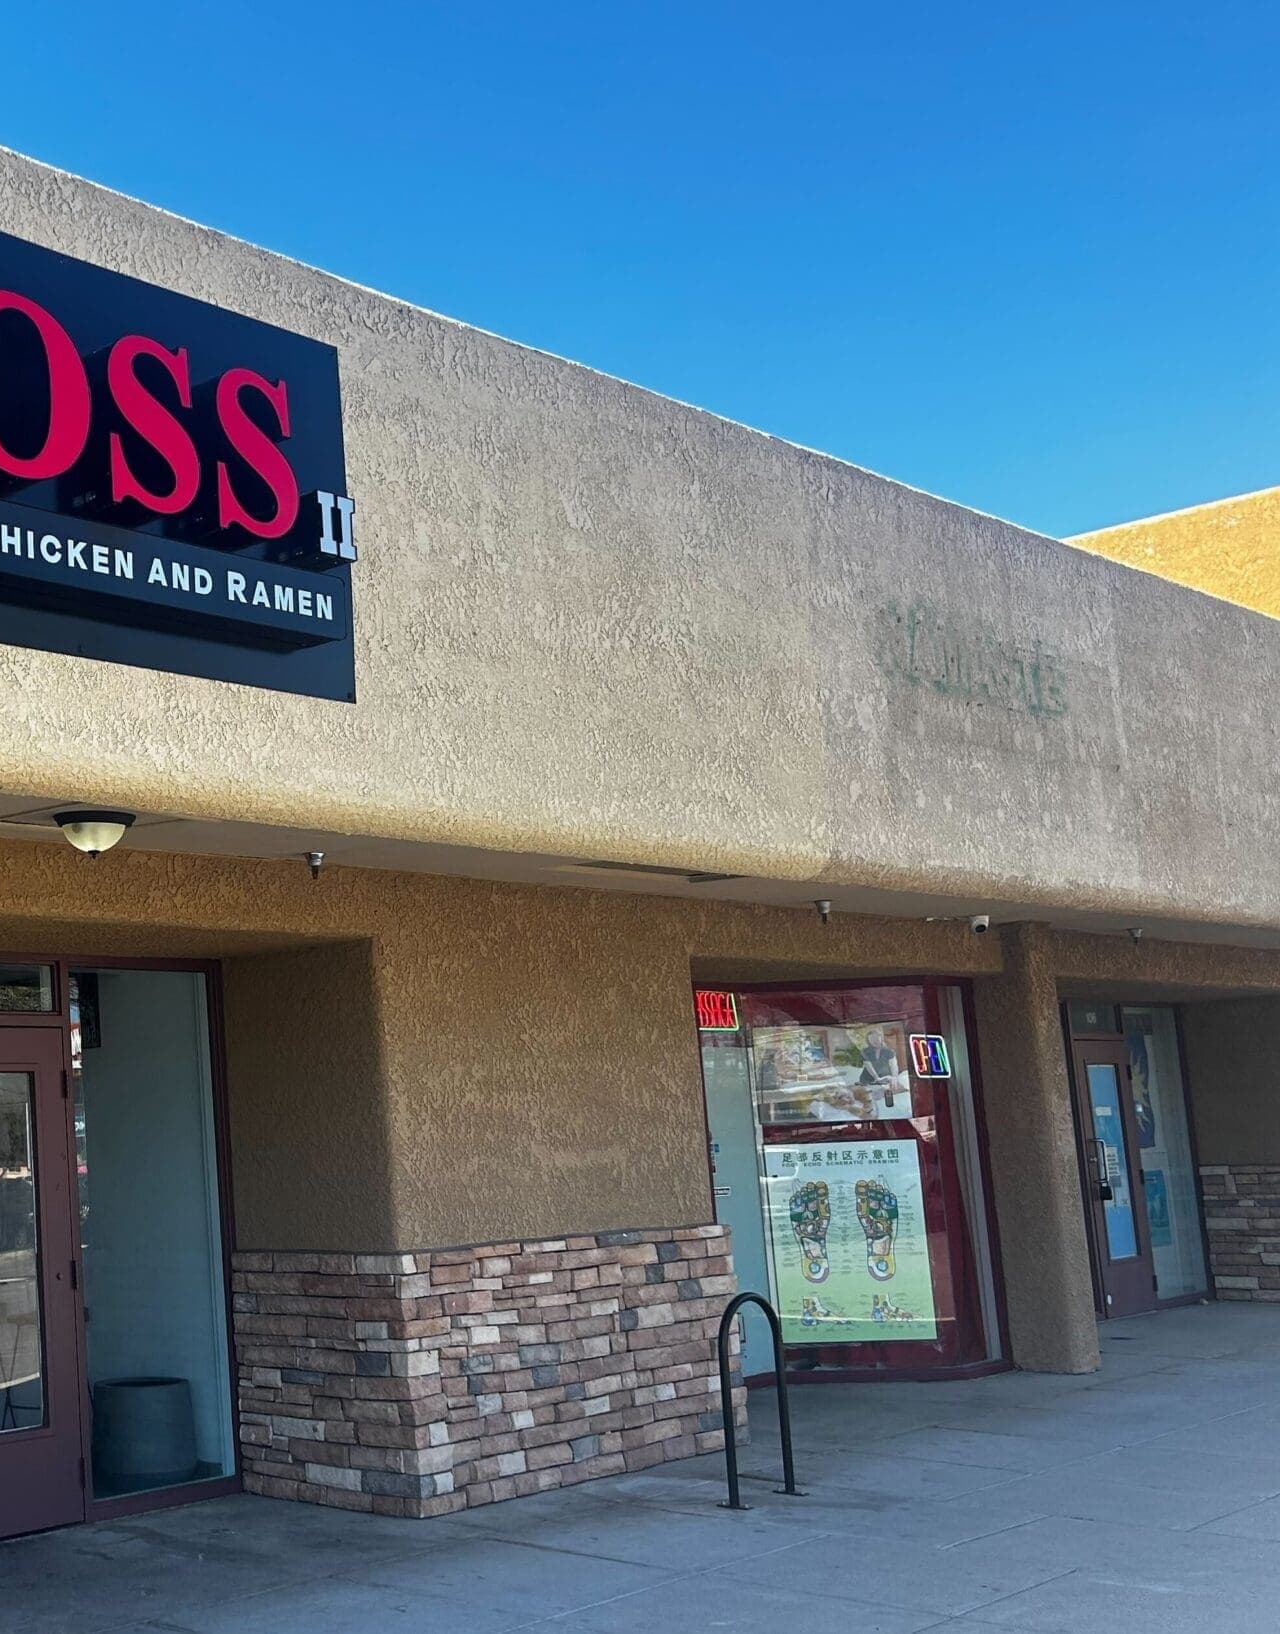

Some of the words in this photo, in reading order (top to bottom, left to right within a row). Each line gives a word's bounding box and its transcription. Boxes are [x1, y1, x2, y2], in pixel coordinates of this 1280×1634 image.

[317, 490, 356, 562] II
[147, 557, 213, 595] AND
[227, 570, 333, 621] RAMEN
[913, 1039, 949, 1073] OPEN
[782, 1148, 900, 1163] 足部反射区示意图
